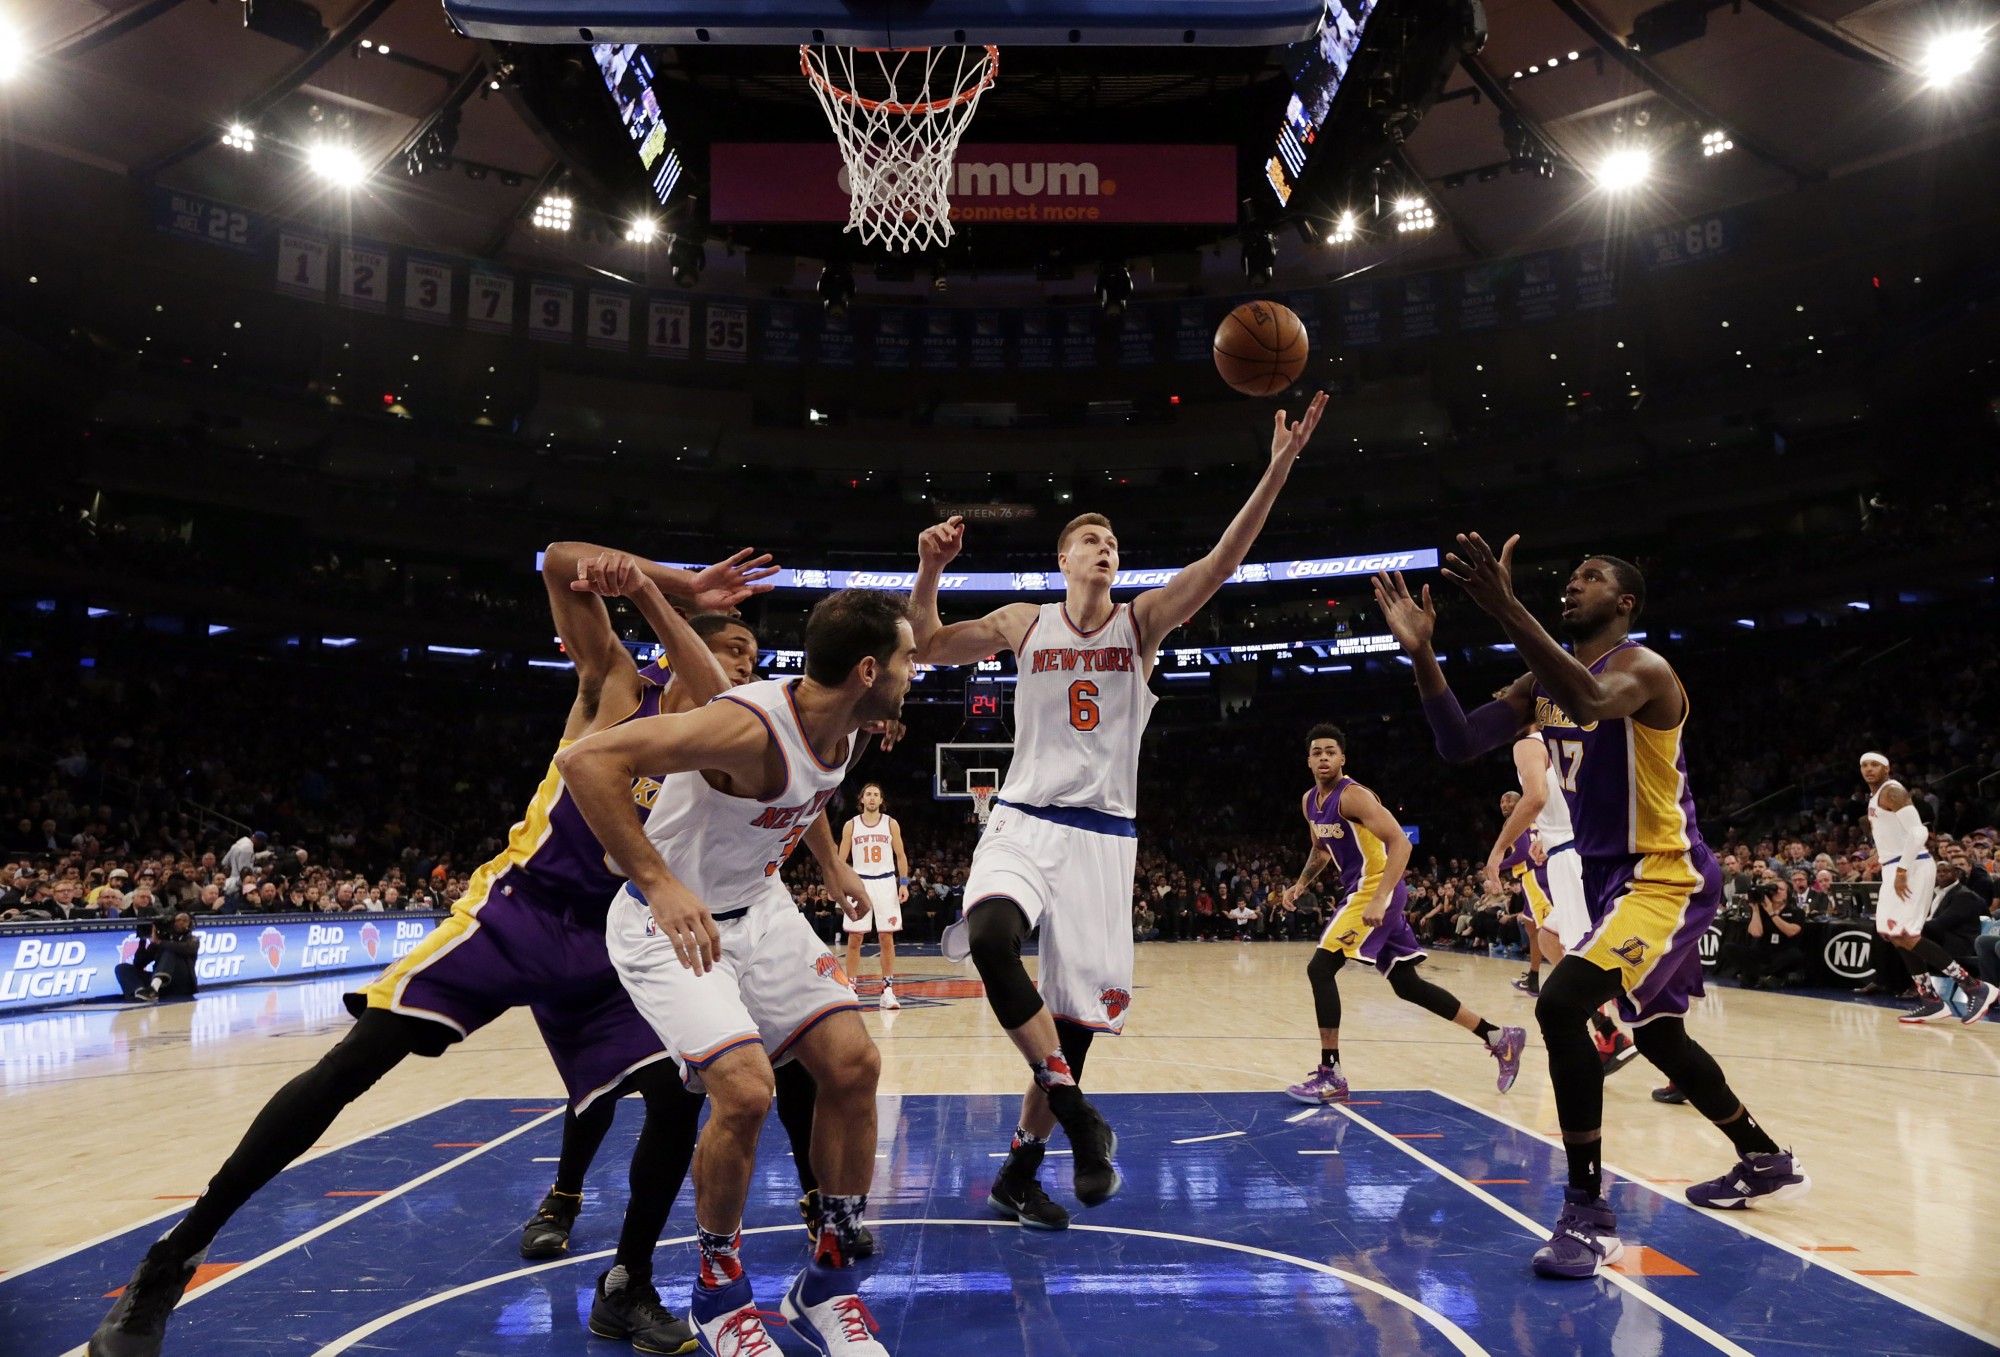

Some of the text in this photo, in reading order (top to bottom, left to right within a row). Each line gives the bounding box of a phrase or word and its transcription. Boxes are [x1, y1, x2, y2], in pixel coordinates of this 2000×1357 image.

[948, 203, 1037, 220] connect
[1043, 207, 1099, 220] more
[208, 207, 248, 244] 22
[1686, 218, 1723, 255] 68
[296, 254, 309, 283] 1
[354, 265, 373, 295] 2
[419, 278, 437, 307] 3
[482, 289, 500, 318] 7
[542, 299, 560, 327] 9
[600, 309, 617, 335] 9
[655, 317, 681, 344] 11
[709, 321, 743, 348] 35
[940, 508, 1012, 518] EIGHTEEN 76
[802, 570, 826, 578] BUD
[1295, 555, 1414, 576] BUD LIGHT
[853, 573, 968, 588] BUD LHT
[1032, 647, 1136, 675] NEW YORK
[972, 696, 996, 714] 24
[1068, 680, 1100, 731] 6
[854, 834, 890, 846] NEW YORK
[863, 845, 882, 863] 18
[308, 924, 344, 946] BUD
[396, 921, 424, 939] BUD
[13, 939, 87, 969] BUD
[195, 954, 245, 980] IGHT
[301, 945, 350, 970] LIGHT
[0, 967, 97, 1001] LIGHT
